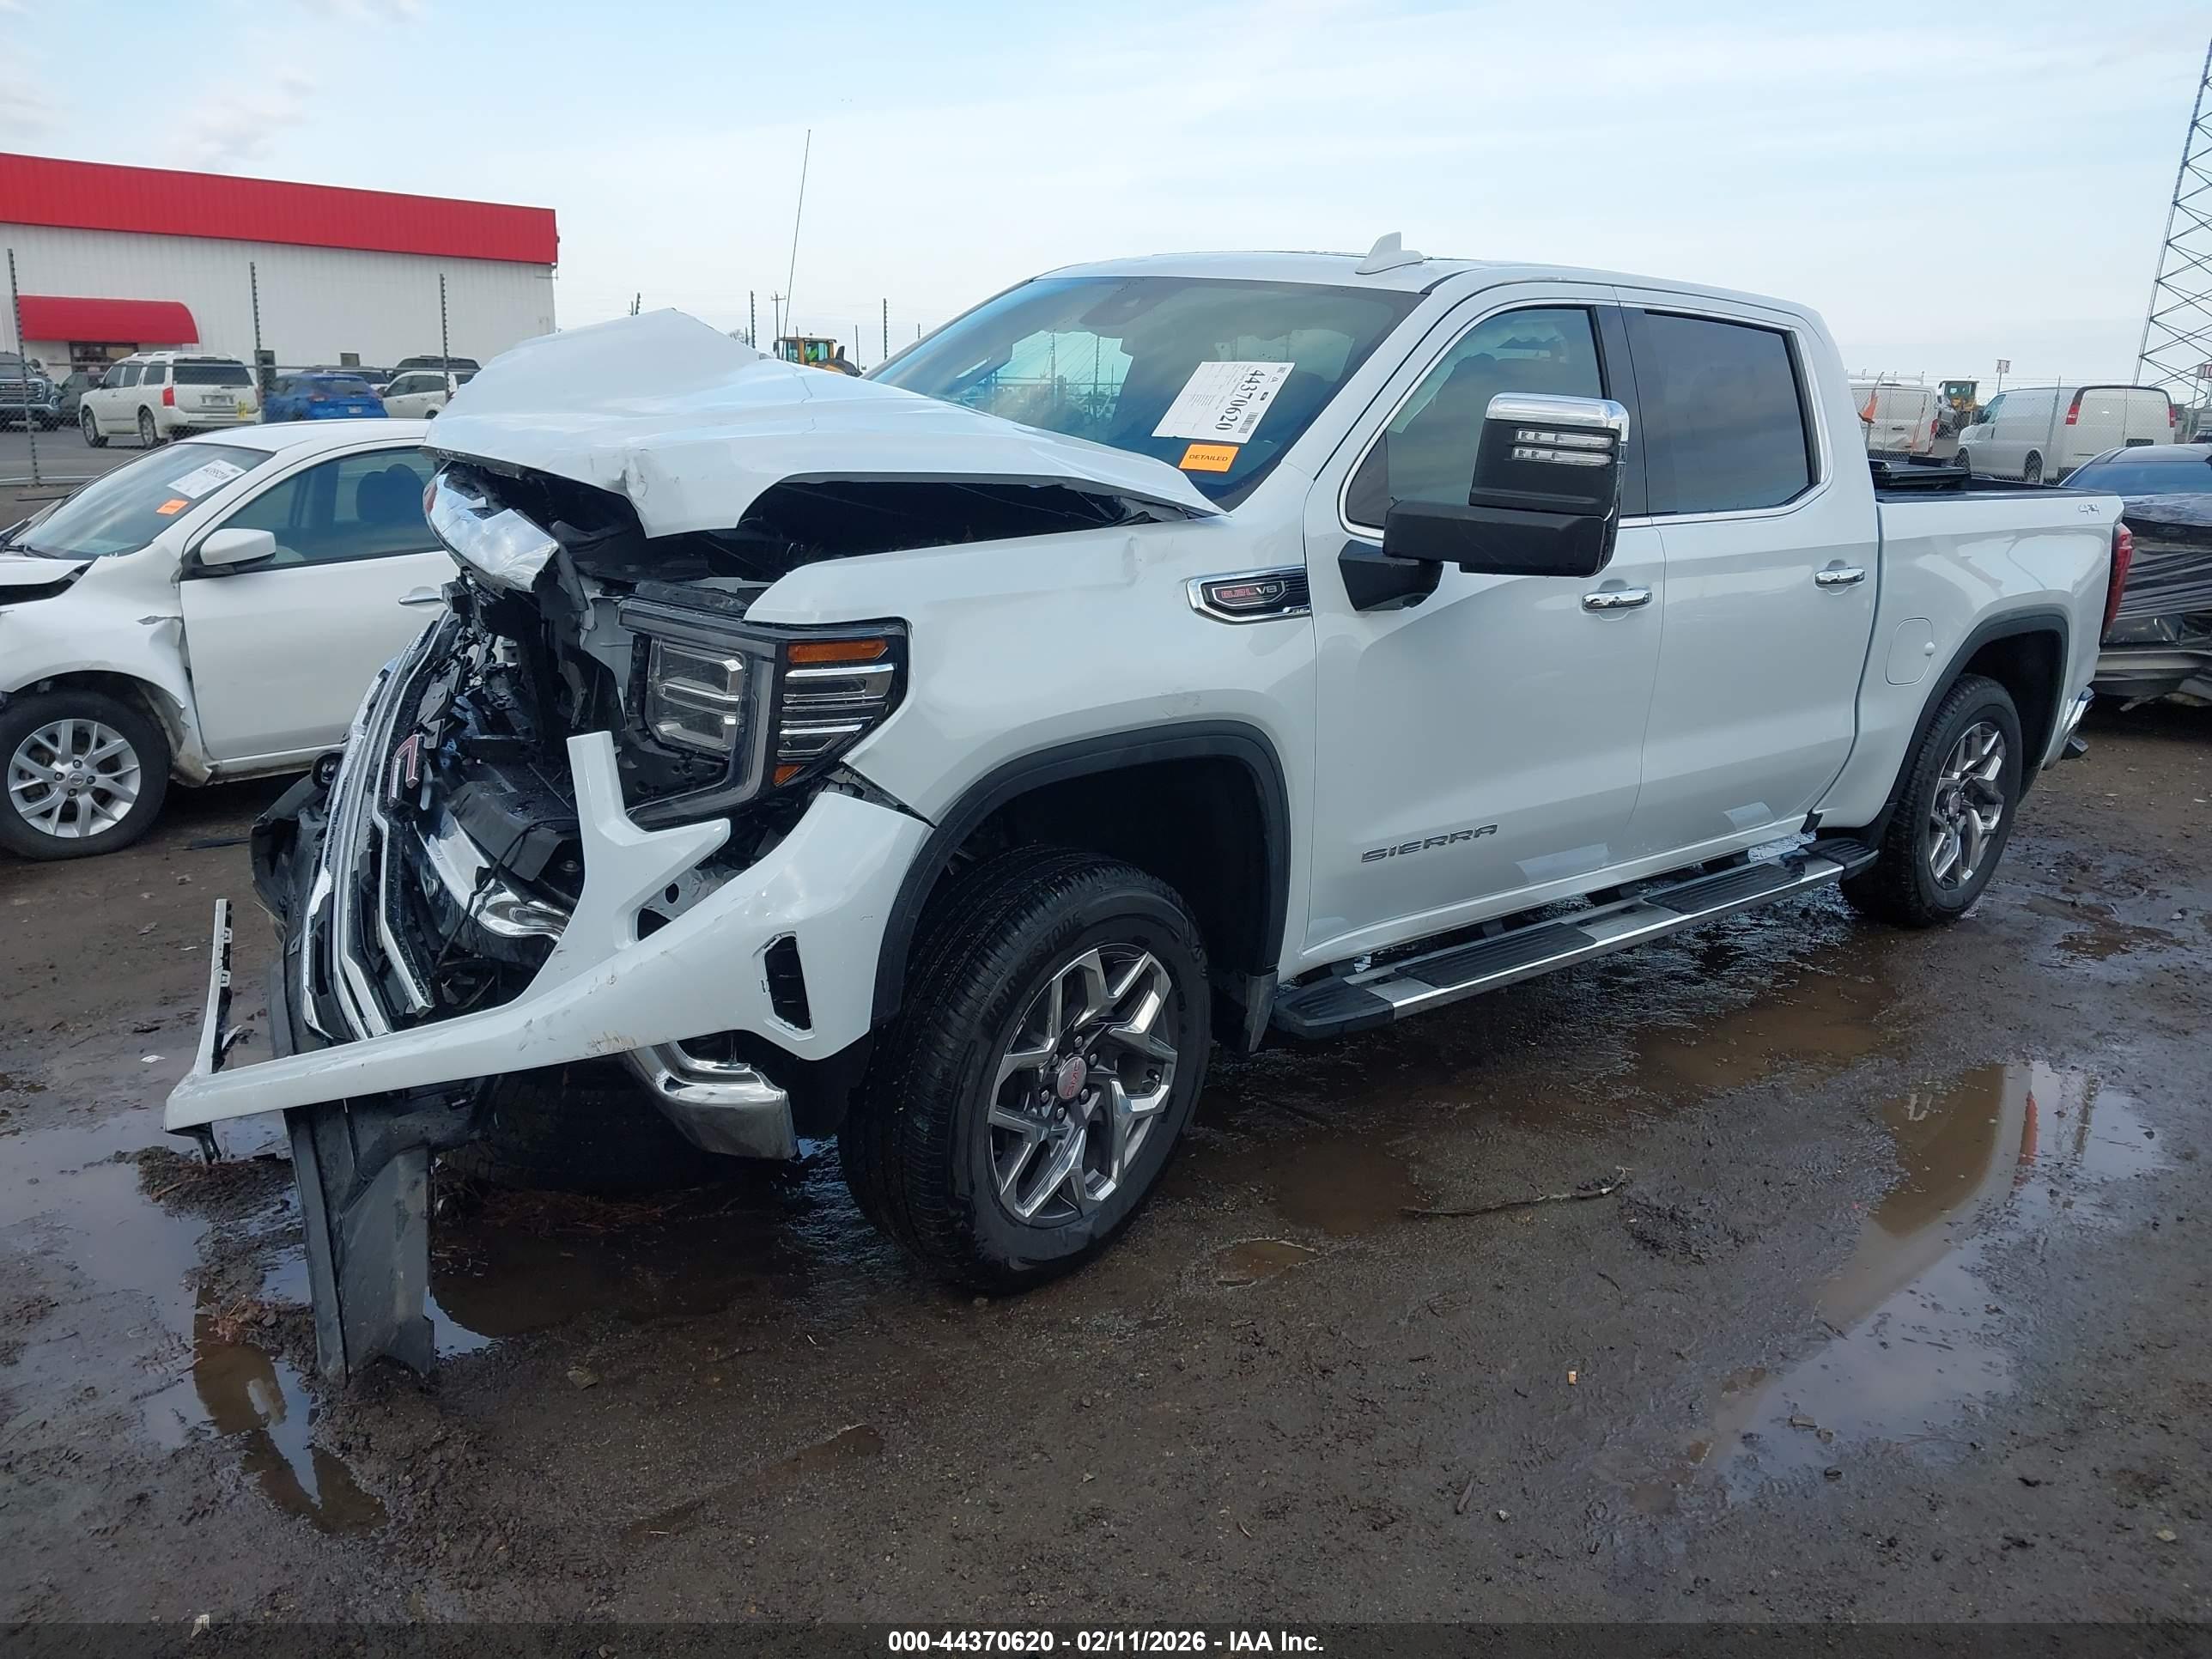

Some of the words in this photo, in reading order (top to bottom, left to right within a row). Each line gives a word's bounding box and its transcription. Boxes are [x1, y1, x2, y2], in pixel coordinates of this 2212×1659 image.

[1214, 369, 1266, 431] 44370620
[1188, 453, 1229, 463] DETAILED
[1255, 585, 1278, 594] V8
[1360, 823, 1498, 863] SIERRA
